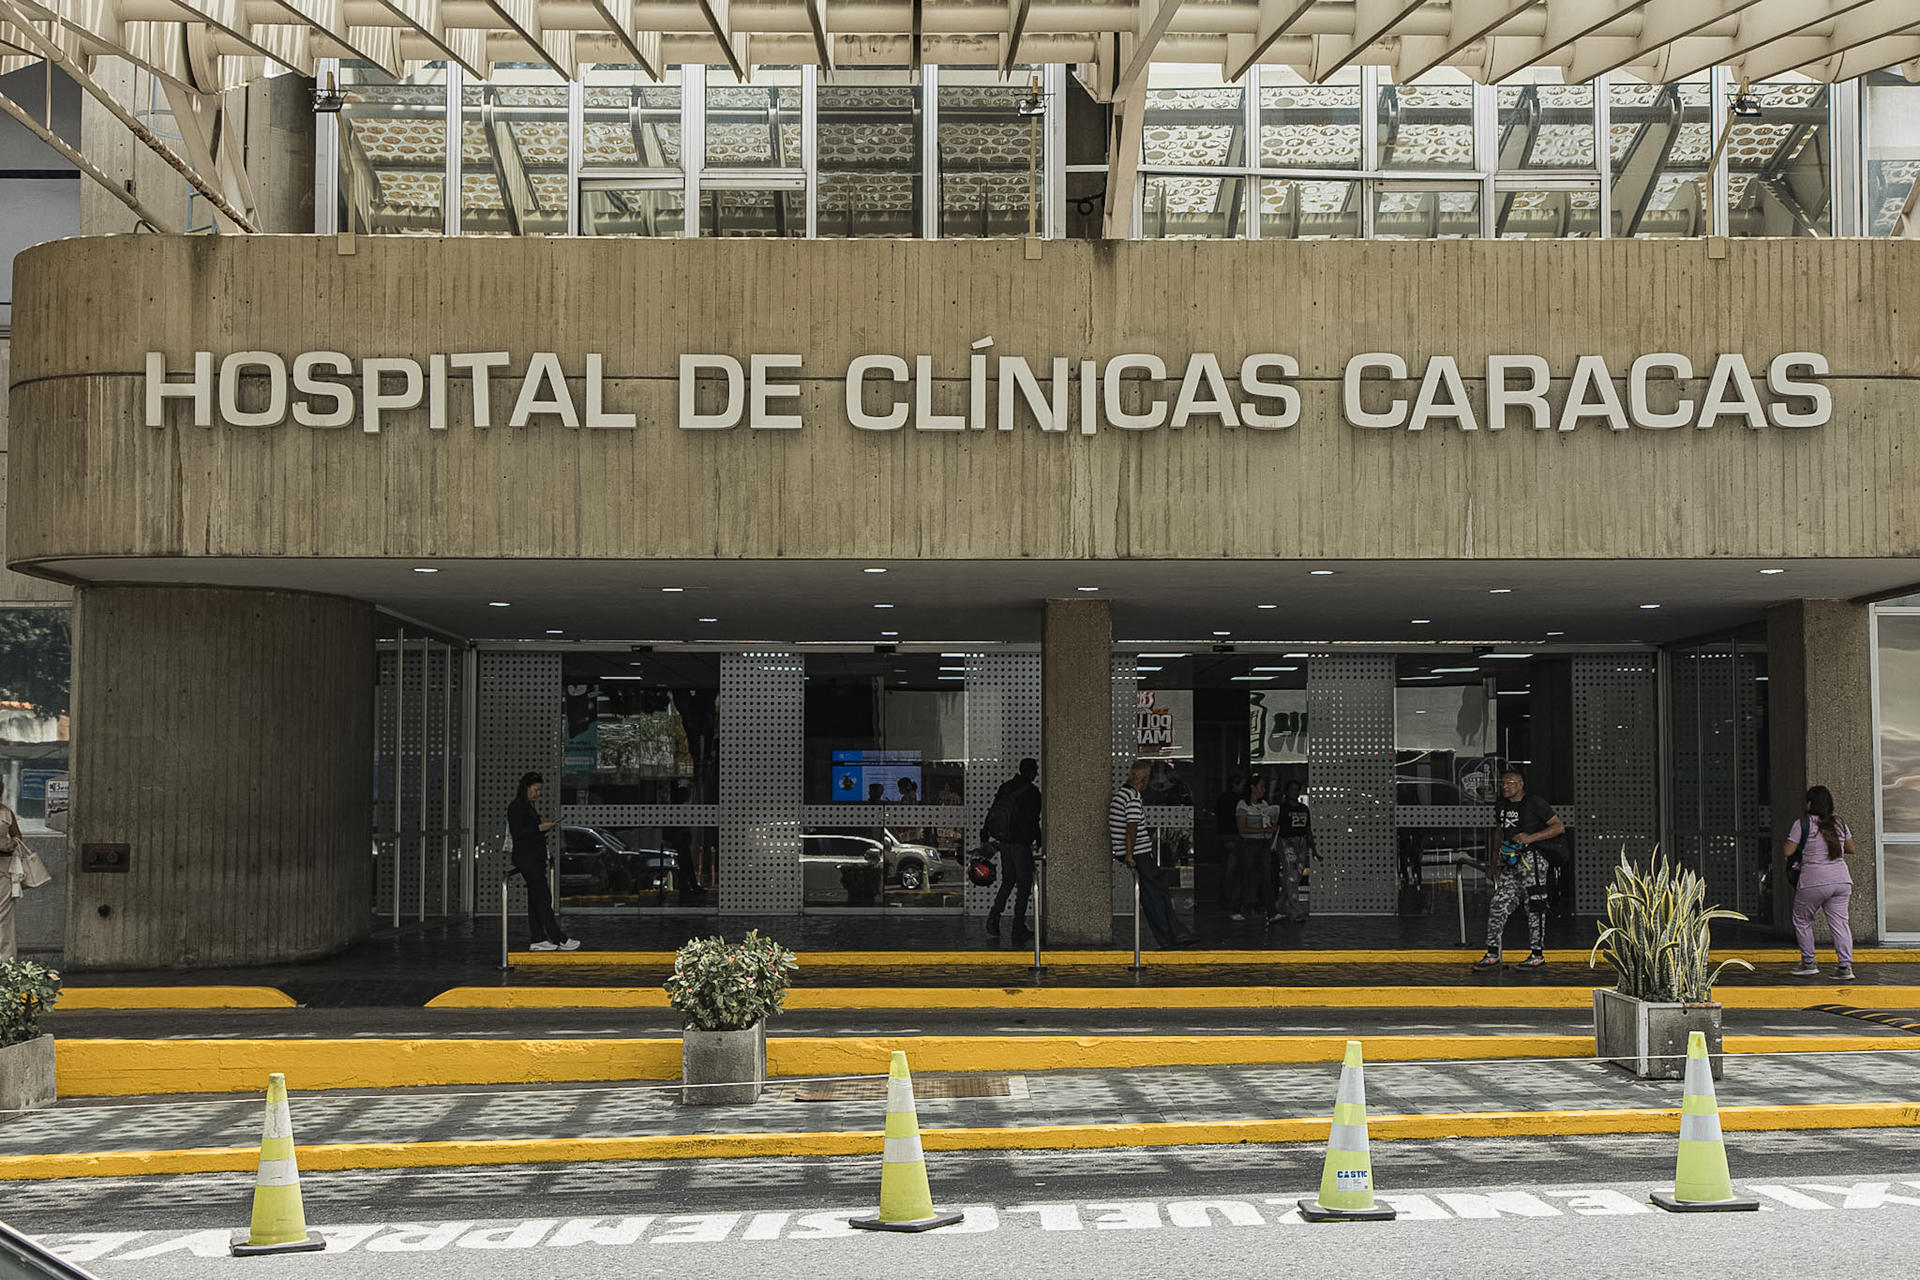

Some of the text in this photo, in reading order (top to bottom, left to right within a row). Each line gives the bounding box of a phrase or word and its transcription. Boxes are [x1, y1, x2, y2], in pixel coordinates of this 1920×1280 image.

[144, 336, 1832, 435] HOSPITAL DE CLÍNICAS CARACAS
[1292, 816, 1307, 827] 23
